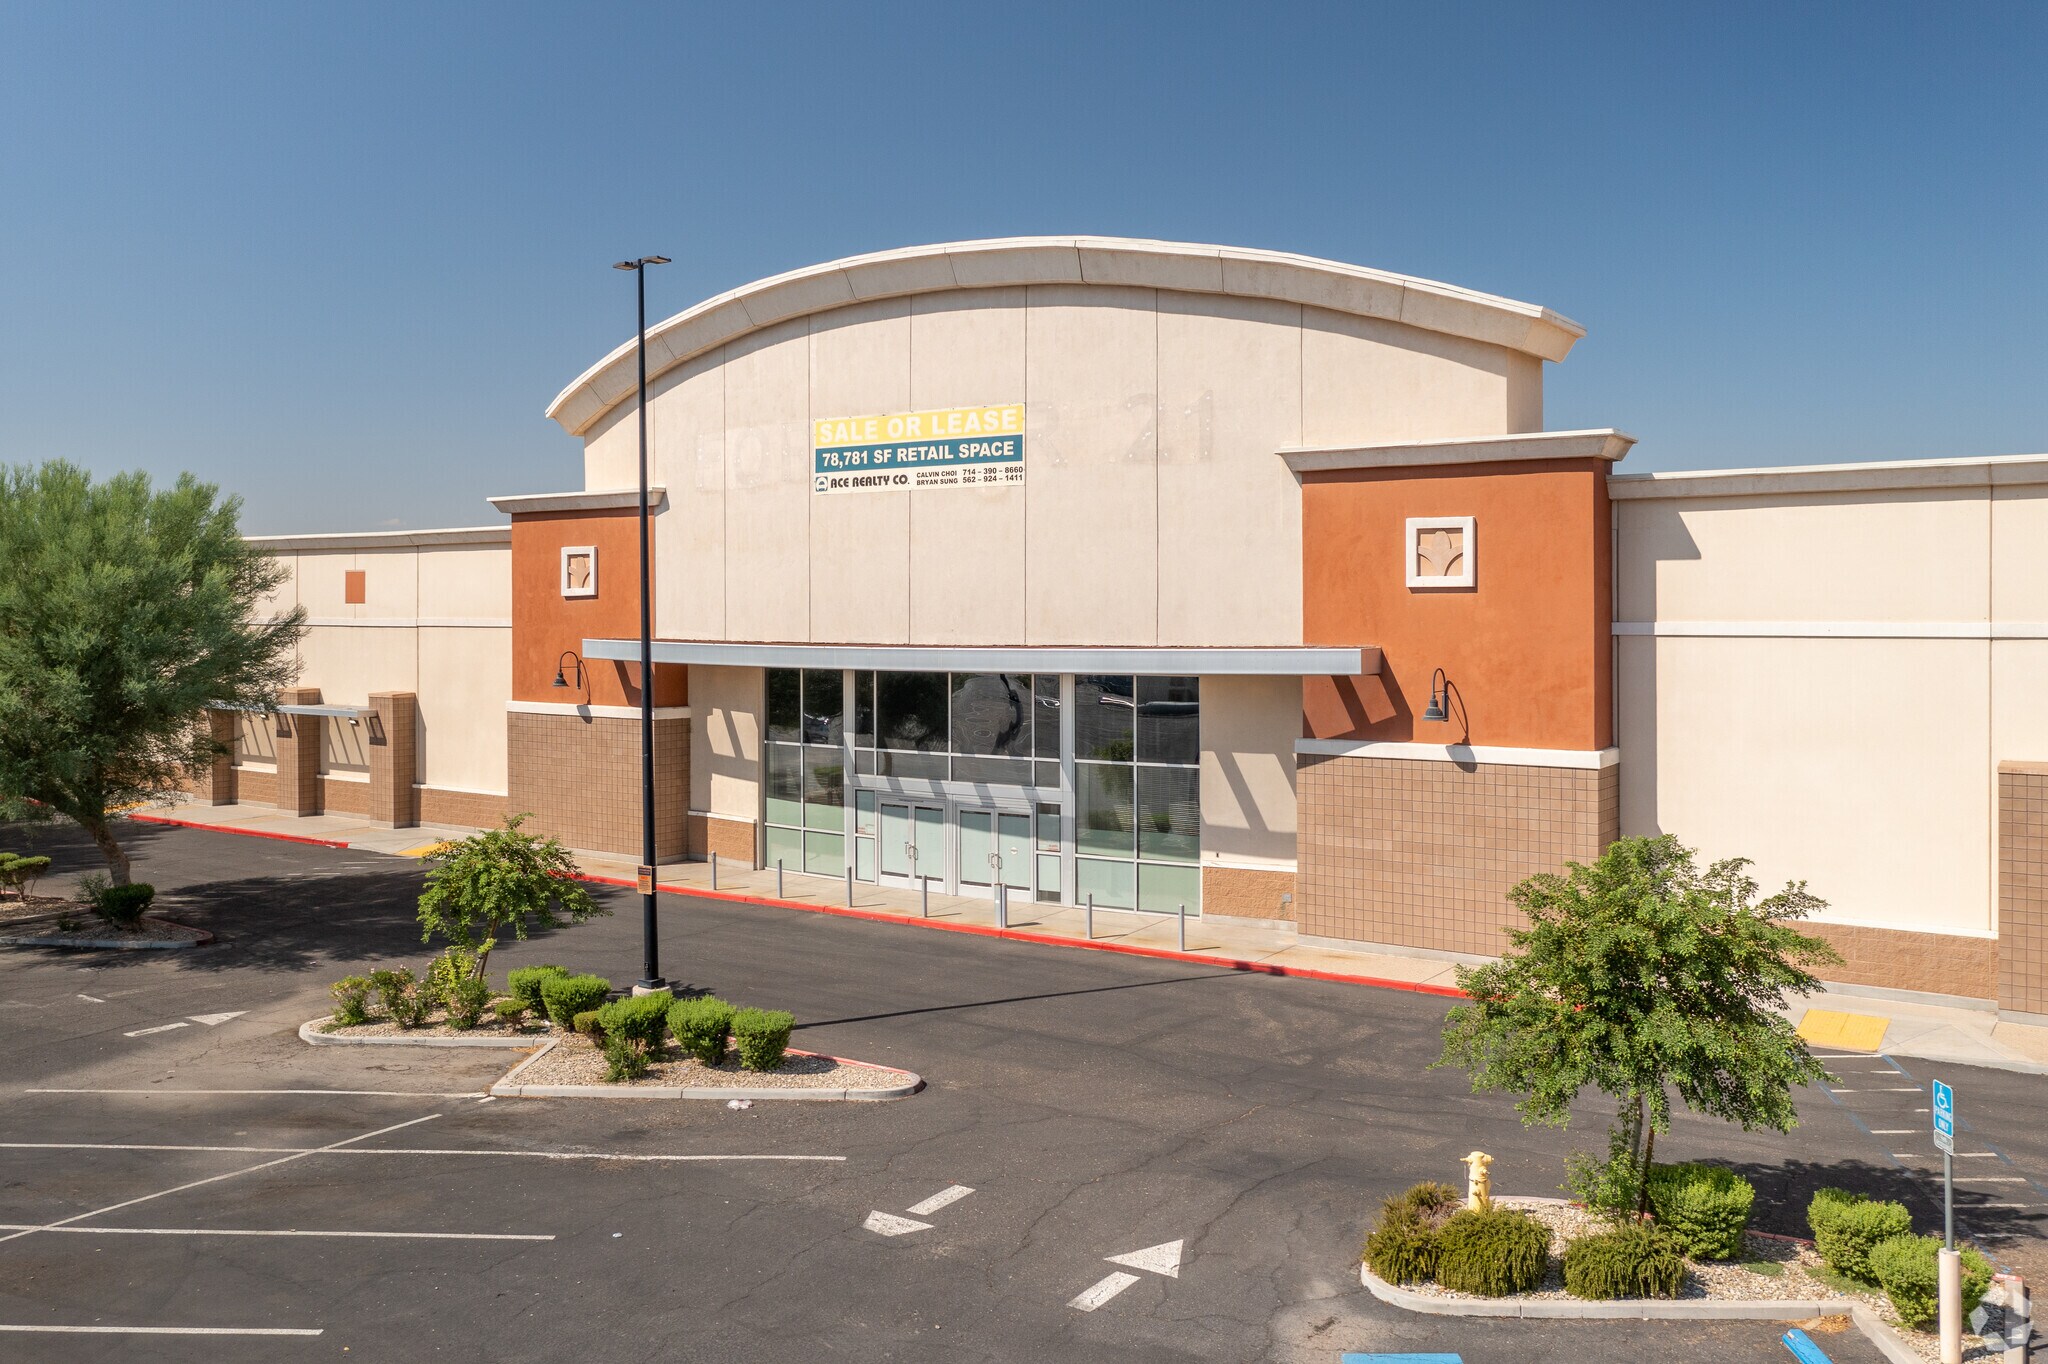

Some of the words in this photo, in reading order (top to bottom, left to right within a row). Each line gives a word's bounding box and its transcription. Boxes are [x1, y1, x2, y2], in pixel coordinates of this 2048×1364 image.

[820, 420, 878, 443] SALE
[887, 416, 922, 438] OR
[932, 409, 1017, 435] LEASE
[822, 450, 868, 469] 78,781
[873, 449, 892, 463] SF
[897, 445, 954, 462] RETAIL
[959, 441, 1014, 458] SPACE
[831, 477, 849, 488] ACE
[852, 475, 890, 487] REALTY
[892, 474, 910, 485] CO.
[983, 467, 997, 475] 390
[1004, 466, 1023, 474] 8660
